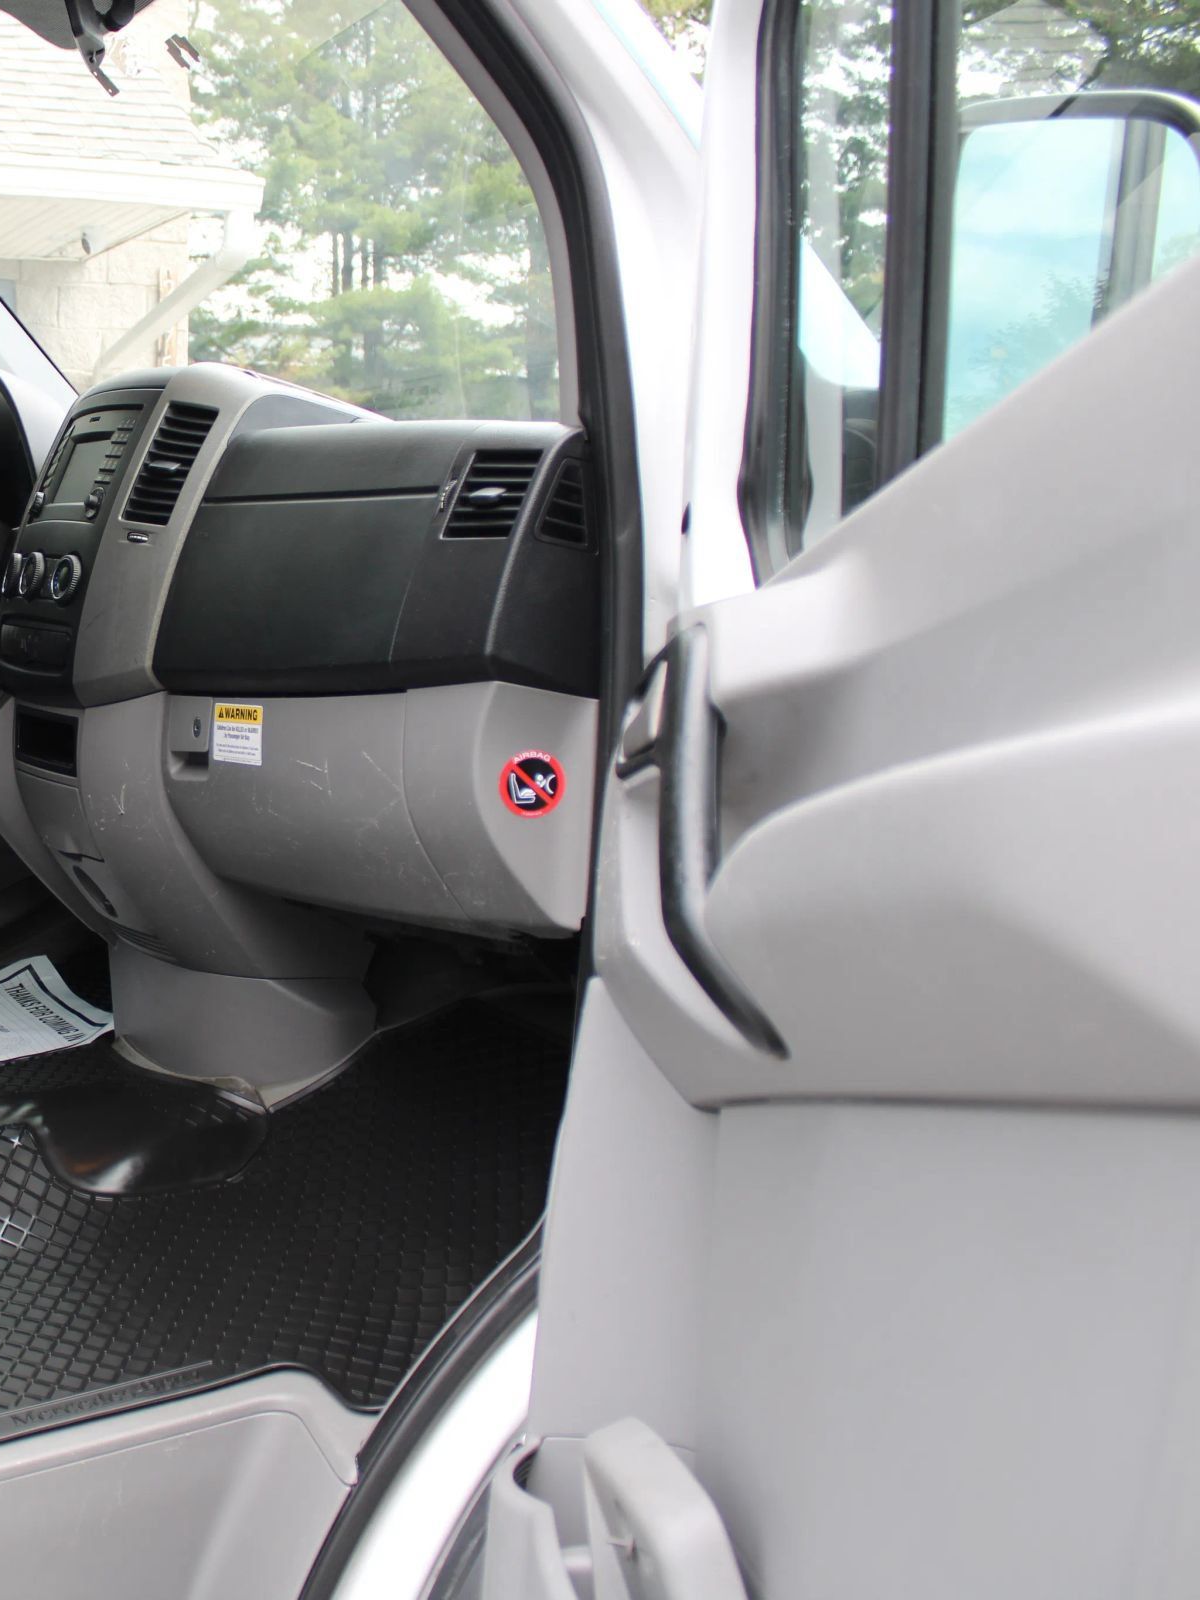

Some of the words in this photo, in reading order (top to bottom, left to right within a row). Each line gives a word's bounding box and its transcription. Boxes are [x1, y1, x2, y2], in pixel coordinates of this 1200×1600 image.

[225, 708, 258, 720] WARNING
[514, 751, 551, 764] AIRBAG
[4, 982, 41, 1007] THANKS
[25, 1003, 54, 1017] FOR
[38, 1014, 79, 1034] COMING
